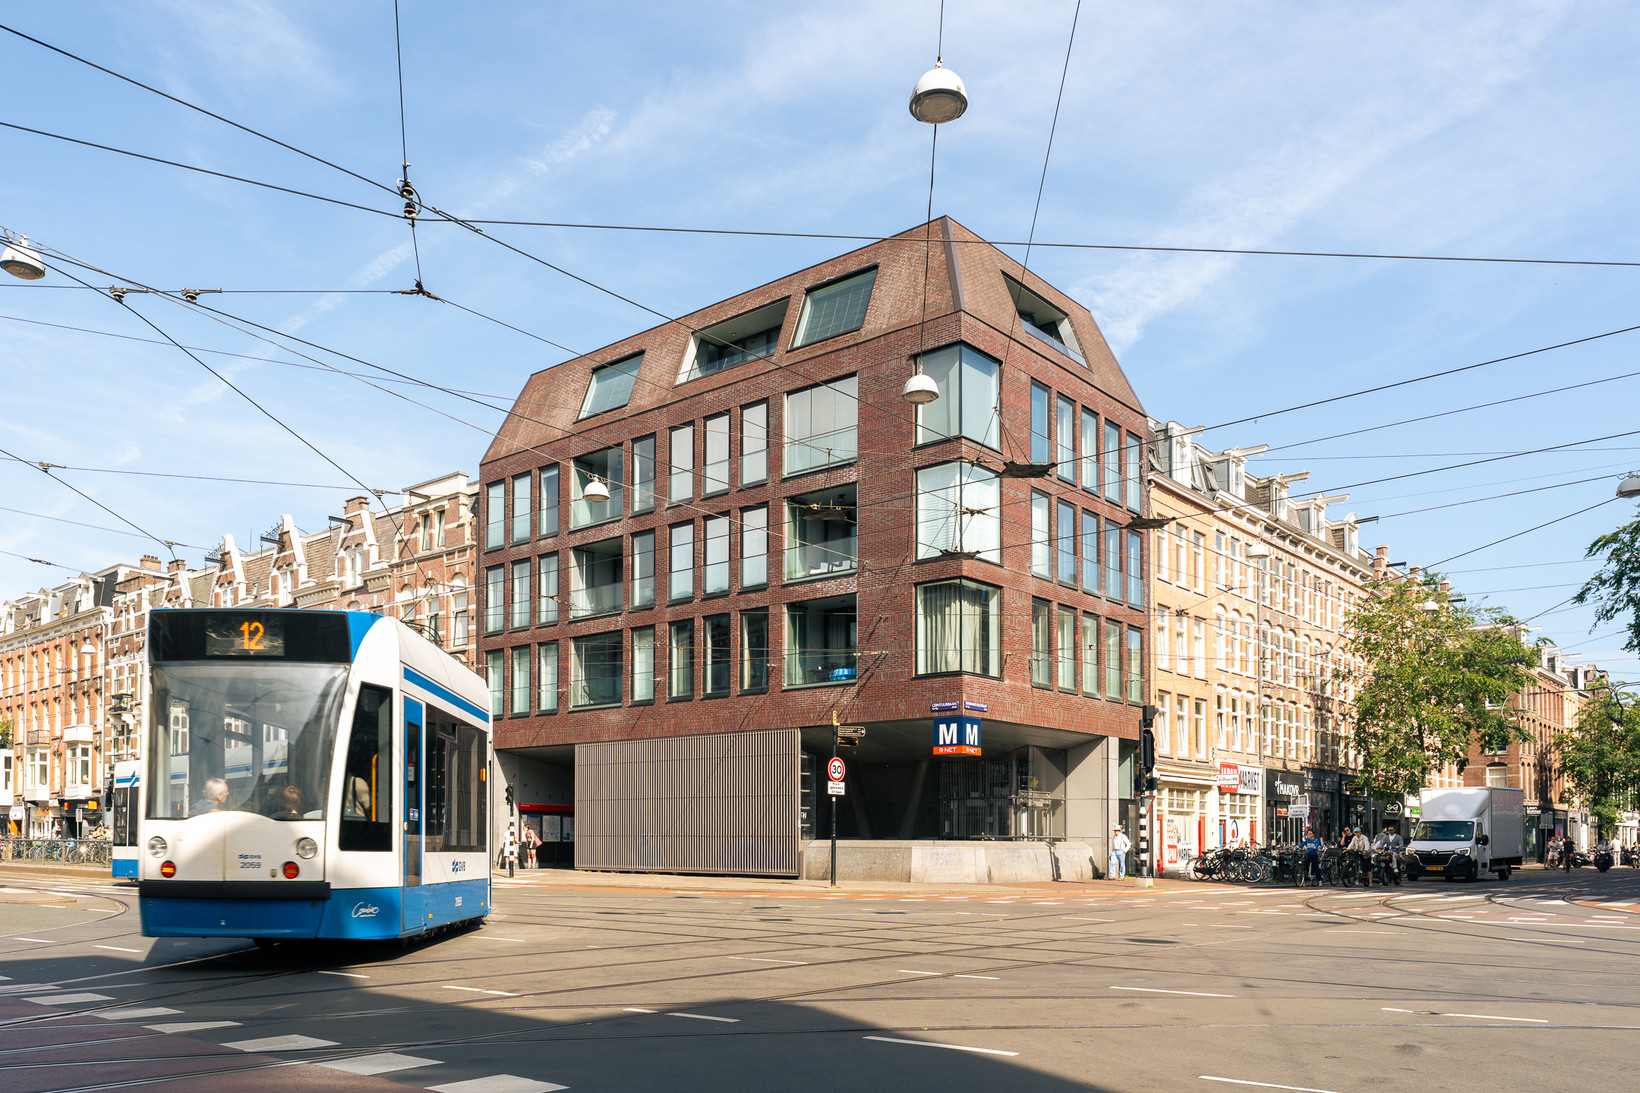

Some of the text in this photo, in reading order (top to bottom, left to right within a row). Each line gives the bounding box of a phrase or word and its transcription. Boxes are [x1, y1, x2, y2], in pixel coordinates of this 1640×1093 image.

[239, 621, 264, 650] 12
[938, 723, 958, 745] M
[965, 723, 978, 746] M
[832, 765, 842, 774] 30
